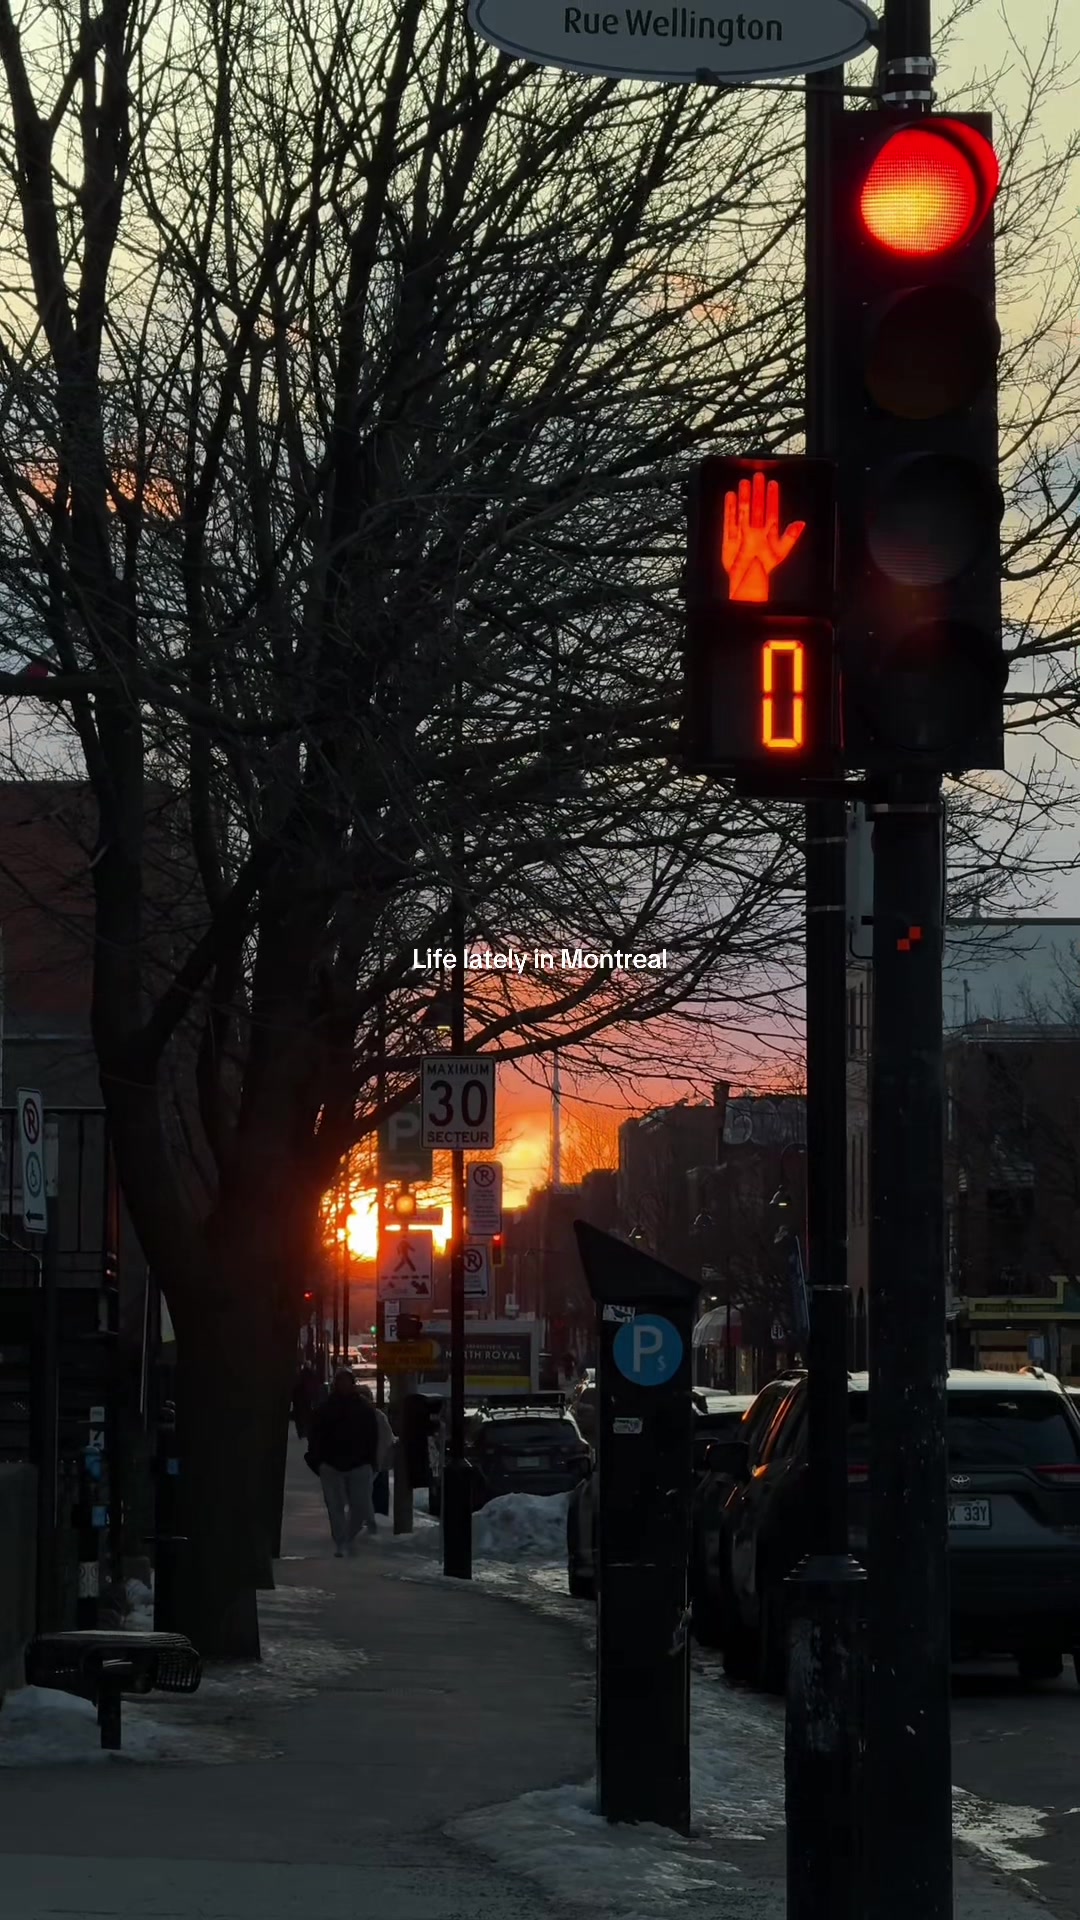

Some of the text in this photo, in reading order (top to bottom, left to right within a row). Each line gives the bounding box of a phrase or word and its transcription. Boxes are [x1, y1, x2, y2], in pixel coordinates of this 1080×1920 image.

[564, 6, 783, 47] Rue Wellington
[427, 1064, 489, 1075] MAXIMUM
[428, 1079, 488, 1127] 30
[388, 1111, 420, 1151] P
[427, 1131, 489, 1143] SECTEUR
[444, 1350, 521, 1360] NTH ROYAL
[963, 1506, 987, 1521] 33Y
